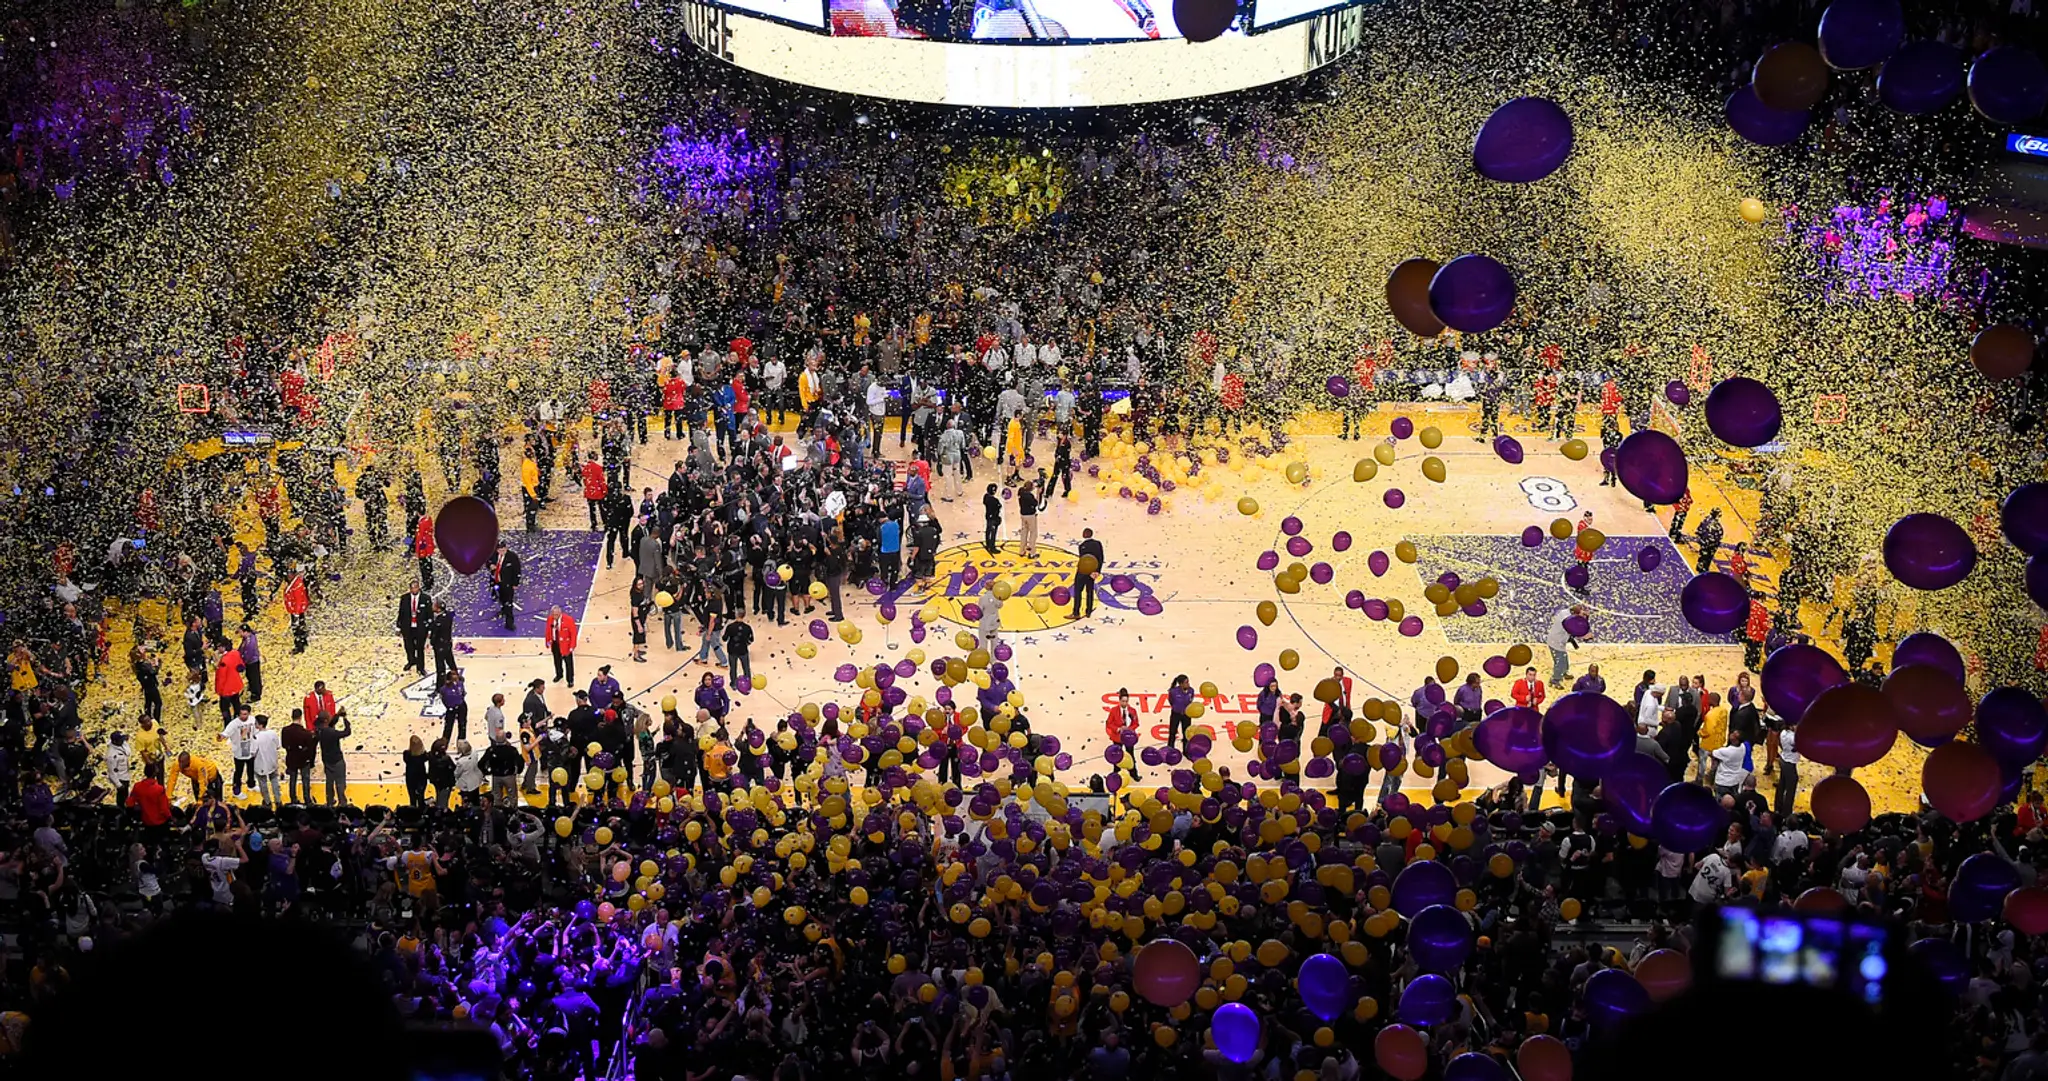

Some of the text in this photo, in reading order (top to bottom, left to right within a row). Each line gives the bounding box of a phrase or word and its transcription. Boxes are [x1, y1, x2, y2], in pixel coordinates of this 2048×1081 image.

[1517, 475, 1578, 512] 8
[1023, 560, 1162, 569] ANGLES
[1101, 692, 1291, 714] STALE
[1701, 866, 1718, 886] 24
